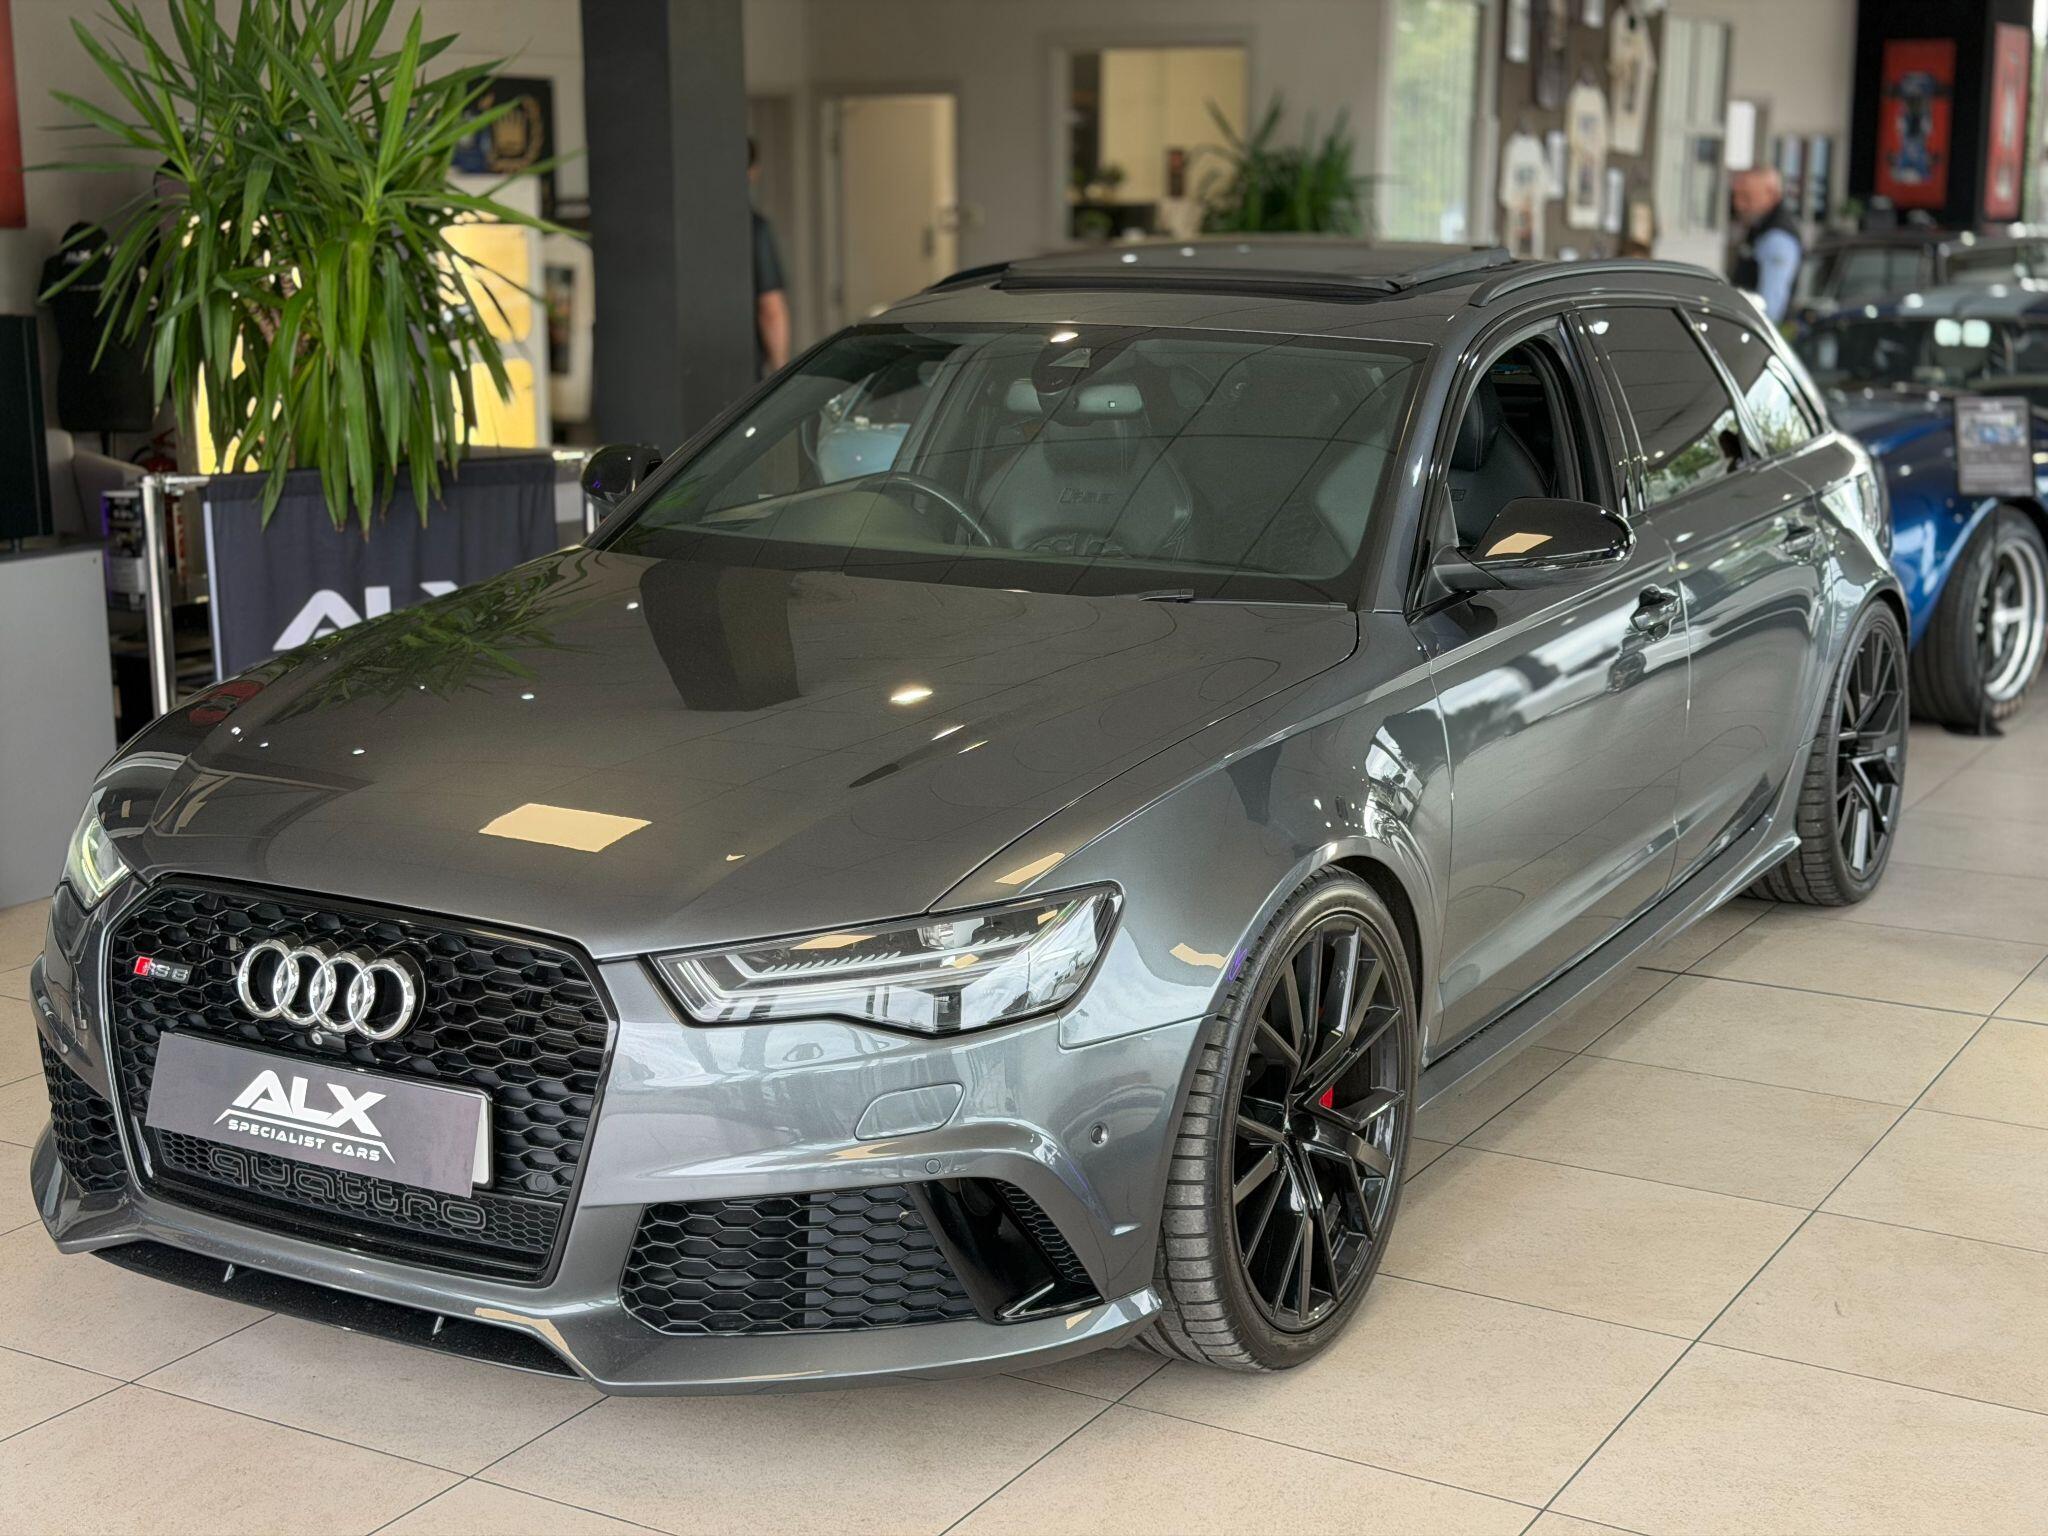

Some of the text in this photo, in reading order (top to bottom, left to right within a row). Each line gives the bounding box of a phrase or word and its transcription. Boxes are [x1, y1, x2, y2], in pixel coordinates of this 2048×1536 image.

[232, 1069, 387, 1138] ALX
[228, 1119, 380, 1162] SPECIALIST CARS
[210, 1148, 487, 1230] quattro
